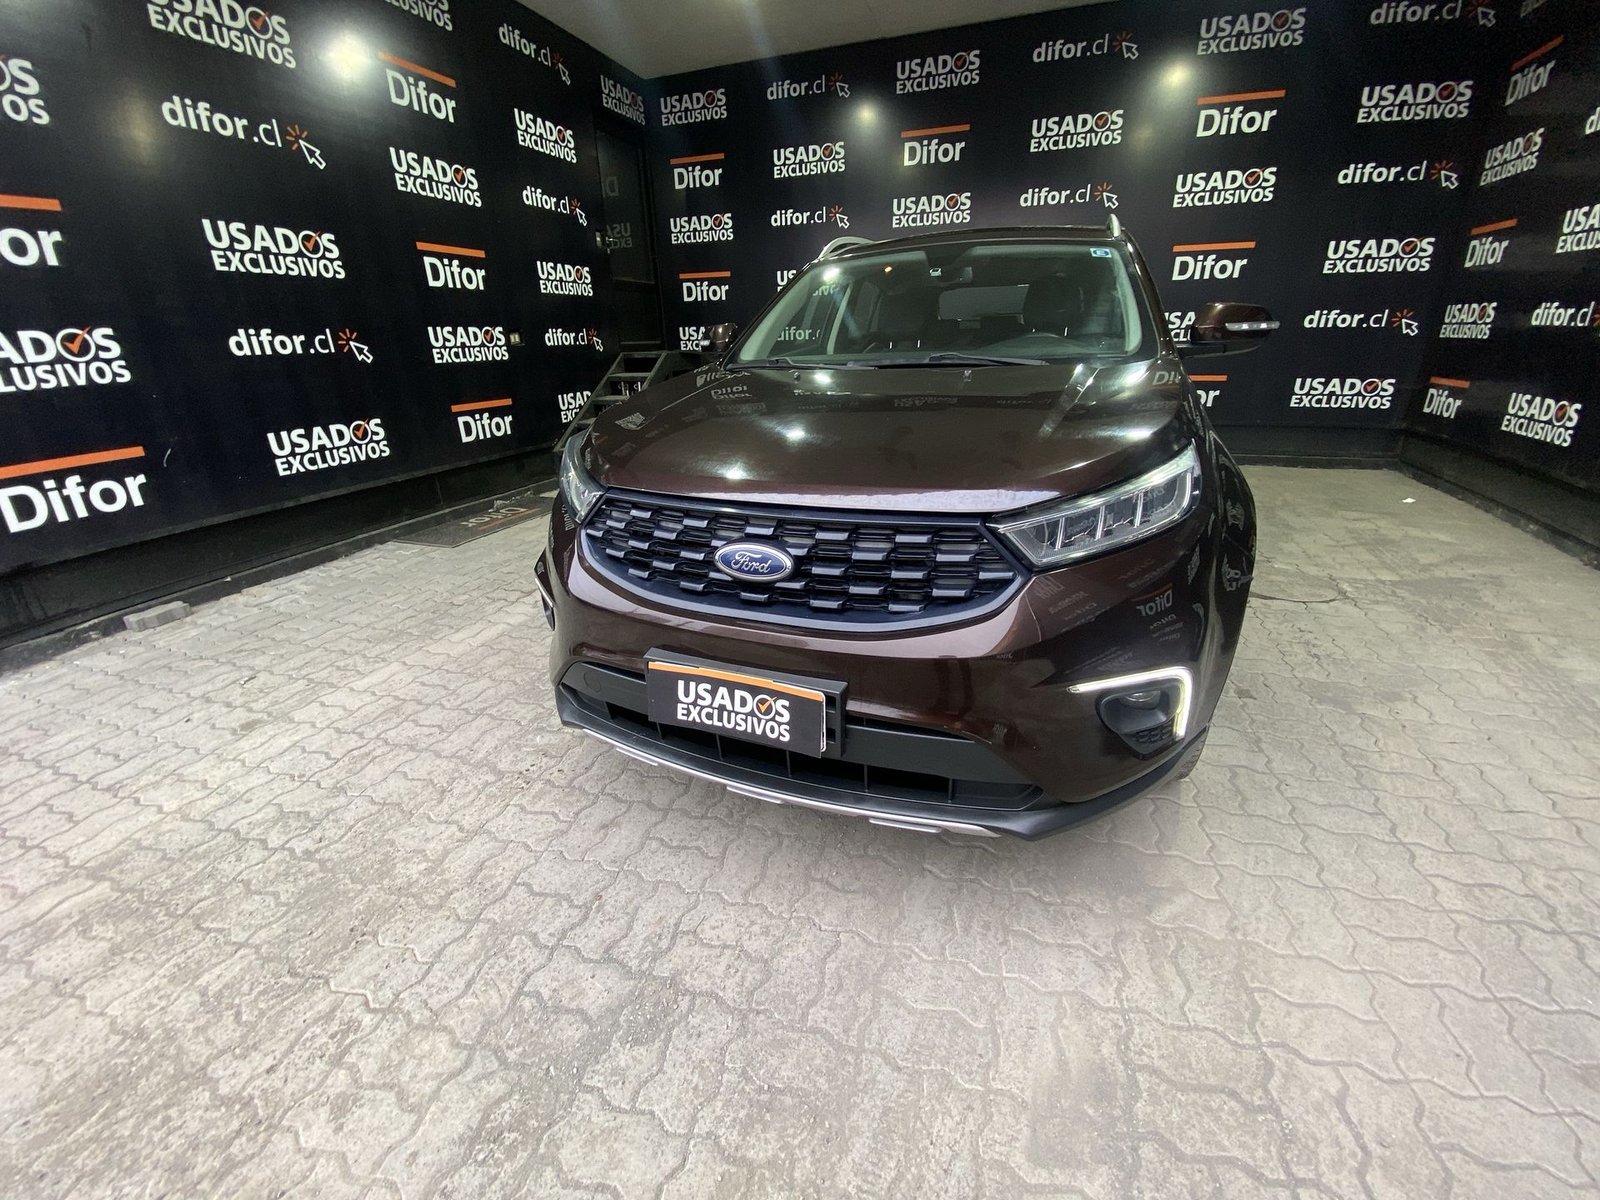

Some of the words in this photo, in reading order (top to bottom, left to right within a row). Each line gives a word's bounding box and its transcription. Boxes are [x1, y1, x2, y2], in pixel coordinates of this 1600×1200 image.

[153, 0, 290, 45] ADOS
[1200, 7, 1307, 39] USADOS
[1370, 0, 1462, 25] difor.cl
[147, 3, 296, 69] EXCLUSIVOS
[499, 23, 551, 67] difor.cl
[1032, 33, 1109, 63] difor.cl
[1197, 30, 1304, 56] EXCLUSIVOS
[896, 50, 981, 80] USADOS
[600, 74, 644, 112] USADOS
[766, 74, 826, 100] difor.cl
[896, 70, 980, 94] EXCLUSIVOS
[1361, 80, 1474, 107] USADOS
[1504, 60, 1556, 107] Difor
[386, 68, 456, 123] Difor
[660, 88, 726, 113] USADOS
[161, 96, 282, 147] difor.cl
[661, 106, 728, 127] EXCLUSIVOS
[1031, 109, 1124, 138] USADOS
[1196, 106, 1277, 138] Difor
[1356, 102, 1470, 124] EXCLUSIVOS
[514, 108, 575, 148] USADOS
[517, 130, 577, 164] EXCLUSIVOS
[773, 141, 845, 165] USADOS
[903, 138, 966, 167] Difor
[1030, 130, 1122, 153] EXCLUSIVOS
[1484, 127, 1545, 169] USADOS
[389, 147, 479, 190] USADOS
[673, 166, 723, 190] Difor
[773, 160, 846, 179] EXCLUSIVOS
[1175, 167, 1277, 193] USADOS
[1337, 160, 1428, 185] difor.cl
[1479, 152, 1539, 187] EXCLUSIVOS
[395, 173, 482, 208] EXCLUSIVOS
[522, 186, 570, 215] difor.cl
[893, 192, 971, 215] USADOS
[1019, 184, 1092, 208] difor.cl
[1172, 187, 1274, 208] EXCLUSIVOS
[669, 212, 733, 233] USADOS
[770, 206, 826, 227] difor.cl
[892, 210, 971, 228] EXCLUSIVOS
[201, 218, 340, 259] USADOS
[671, 229, 734, 245] EXCLUSIVOS
[1327, 237, 1436, 259] USADOS
[210, 250, 346, 279] EXCLUSIVOS
[1463, 236, 1509, 268] Difor
[423, 256, 486, 290] Difor
[537, 260, 591, 283] USADOS
[1171, 255, 1248, 281] Difor
[1322, 257, 1431, 274] EXCLUSIVOS
[539, 279, 593, 297] EXCLUSIVOS
[682, 281, 729, 302] Difor
[1303, 309, 1389, 328] difor.cl
[1444, 302, 1498, 324] USADOS
[1531, 301, 1595, 326] difor.cl
[228, 328, 336, 357] difor.cl
[427, 326, 506, 347] USADOS
[544, 328, 587, 346] difor.cl
[1439, 324, 1491, 339] EXCLUSIVOS
[432, 345, 509, 364] EXCLUSIVOS
[1293, 378, 1396, 396] USADOS
[1289, 395, 1391, 409] EXCLUSIVOS
[1422, 388, 1462, 419] Difor
[1507, 392, 1582, 428] USADOS
[266, 418, 386, 457] USADOS
[457, 412, 513, 443] Difor
[1500, 414, 1574, 447] EXCLUSIVOS
[275, 440, 391, 477] EXCLUSIVOS
[0, 473, 147, 533] Difor
[731, 551, 770, 574] Ford
[677, 679, 790, 724] USADOS
[676, 702, 790, 742] EXCLUSIVOS
